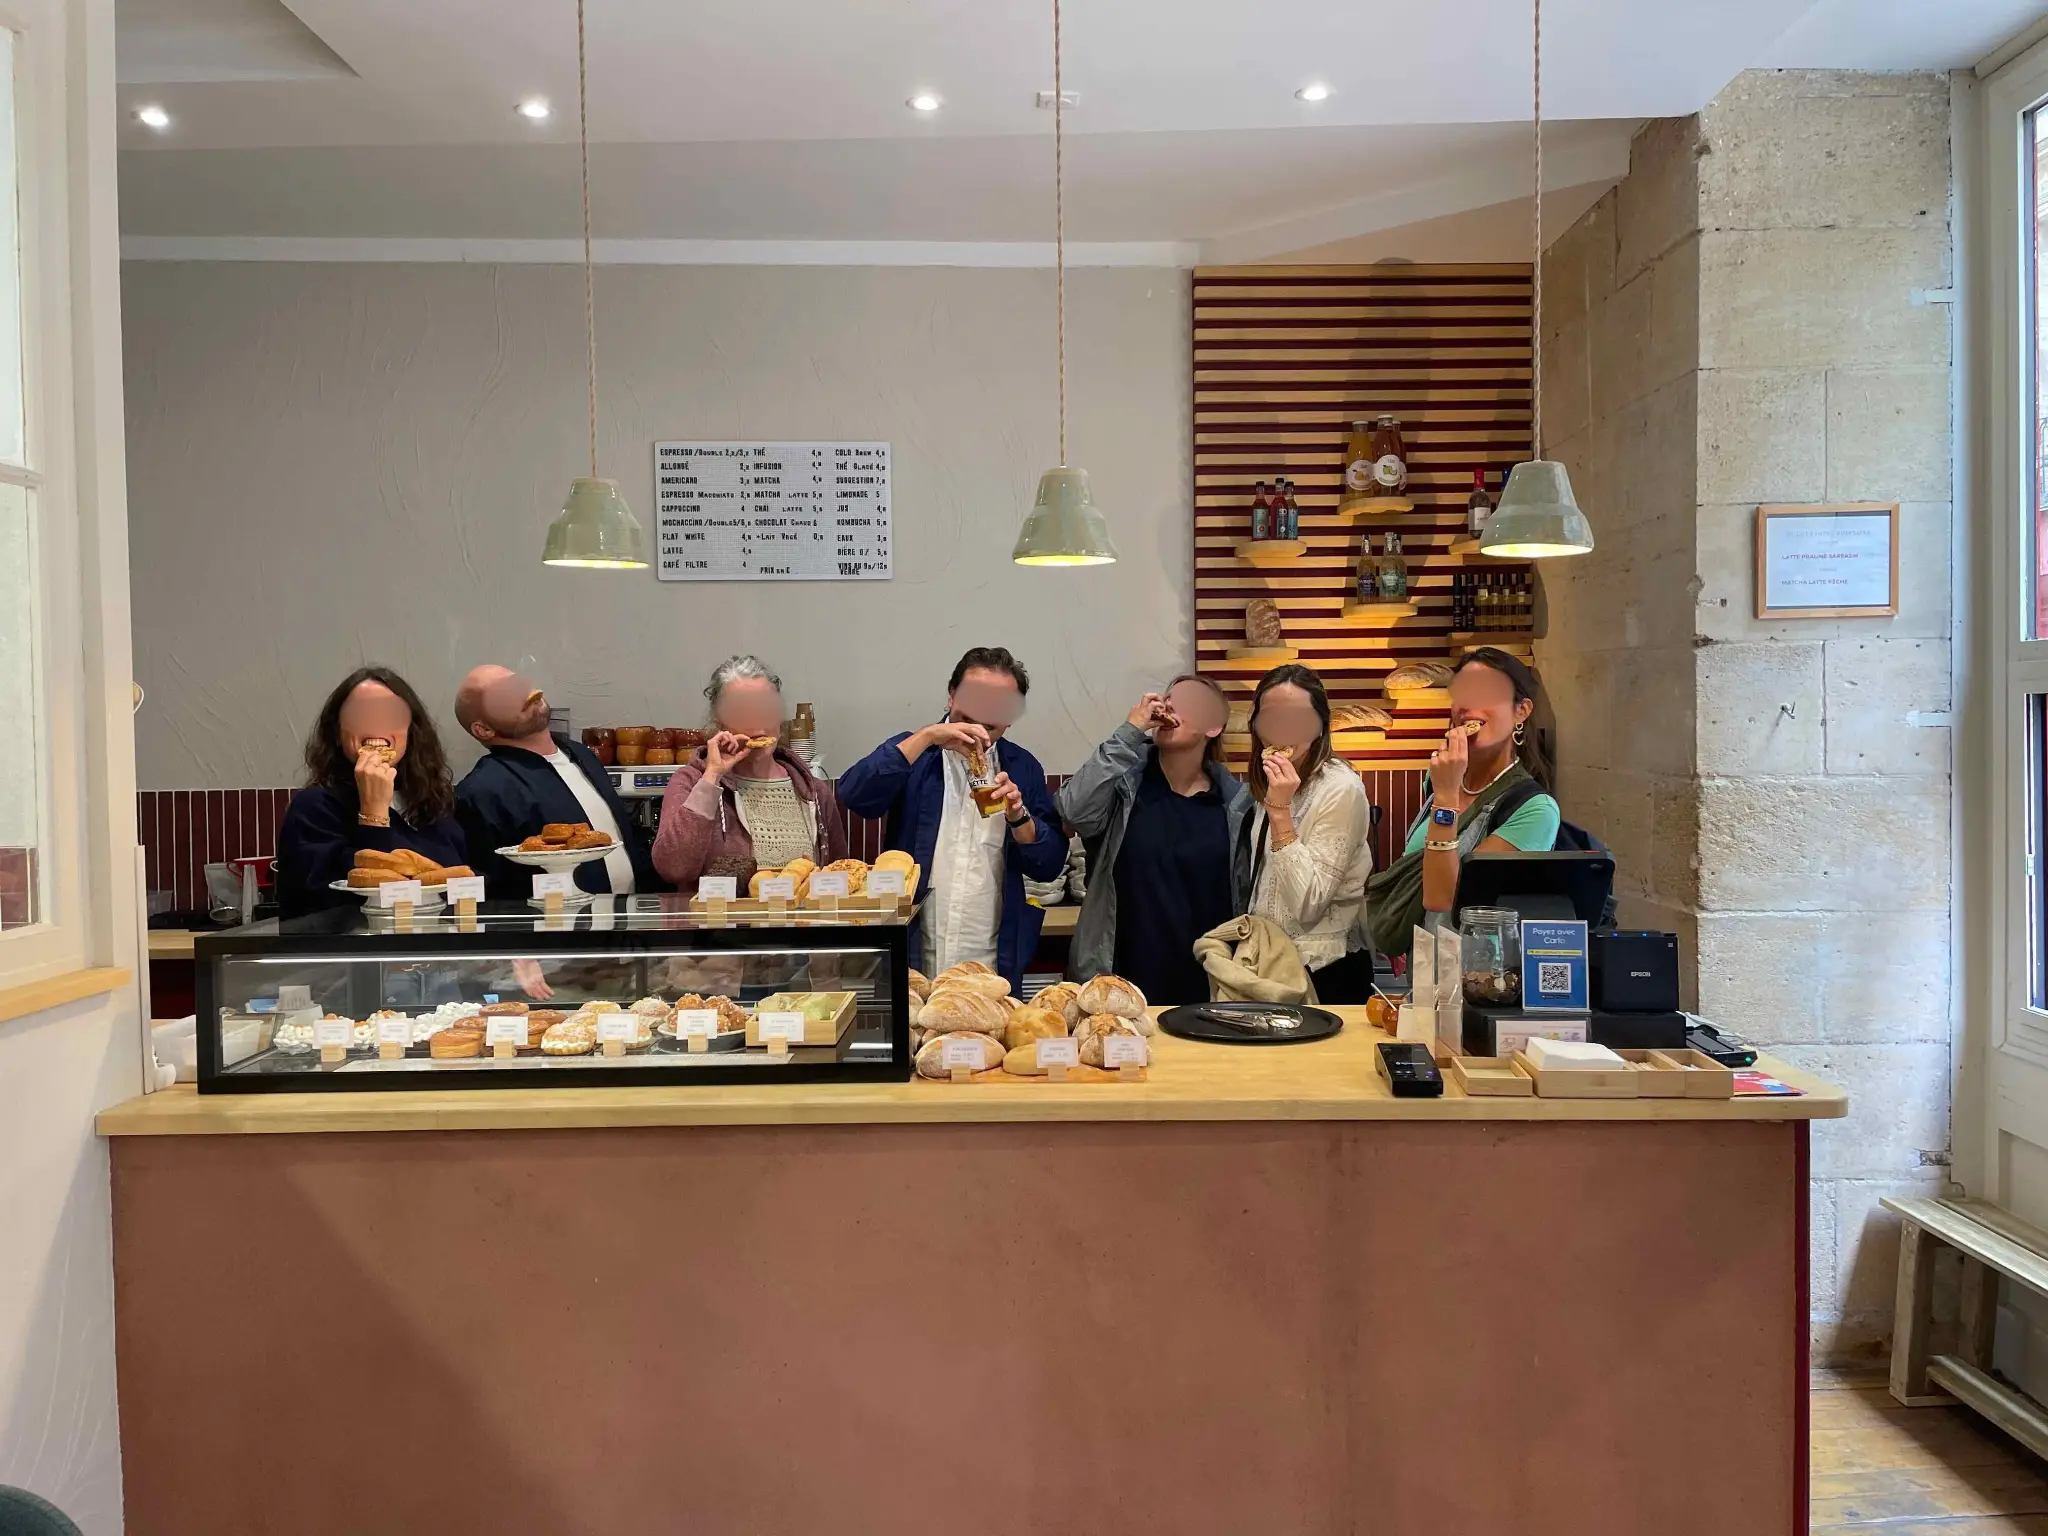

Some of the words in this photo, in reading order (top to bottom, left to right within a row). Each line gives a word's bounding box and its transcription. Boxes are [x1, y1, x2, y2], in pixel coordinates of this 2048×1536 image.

[660, 448, 693, 456] ESPRESSO
[753, 446, 766, 456] THÉ
[835, 448, 852, 456] COLD
[660, 460, 689, 471] ALLONGÉ
[753, 462, 782, 470] INFUSION
[835, 461, 848, 470] THÉ
[661, 476, 698, 484] AMERICANO
[754, 476, 780, 484] MATCHA
[661, 490, 694, 498] ESPRESSO
[754, 490, 781, 498] MATCHA
[836, 490, 868, 498] LIMONADE
[661, 504, 701, 512] CAPPUCCINO
[754, 504, 769, 512] CHAI
[836, 504, 849, 512] JUS
[662, 518, 703, 526] MOCHACCINO
[754, 518, 787, 526] CHOCOLAT
[662, 532, 679, 540] FLAT
[685, 532, 706, 540] WHITE
[662, 546, 684, 554] LATTE
[663, 559, 680, 568] CAFÉ
[1532, 928, 1555, 936] Payez
